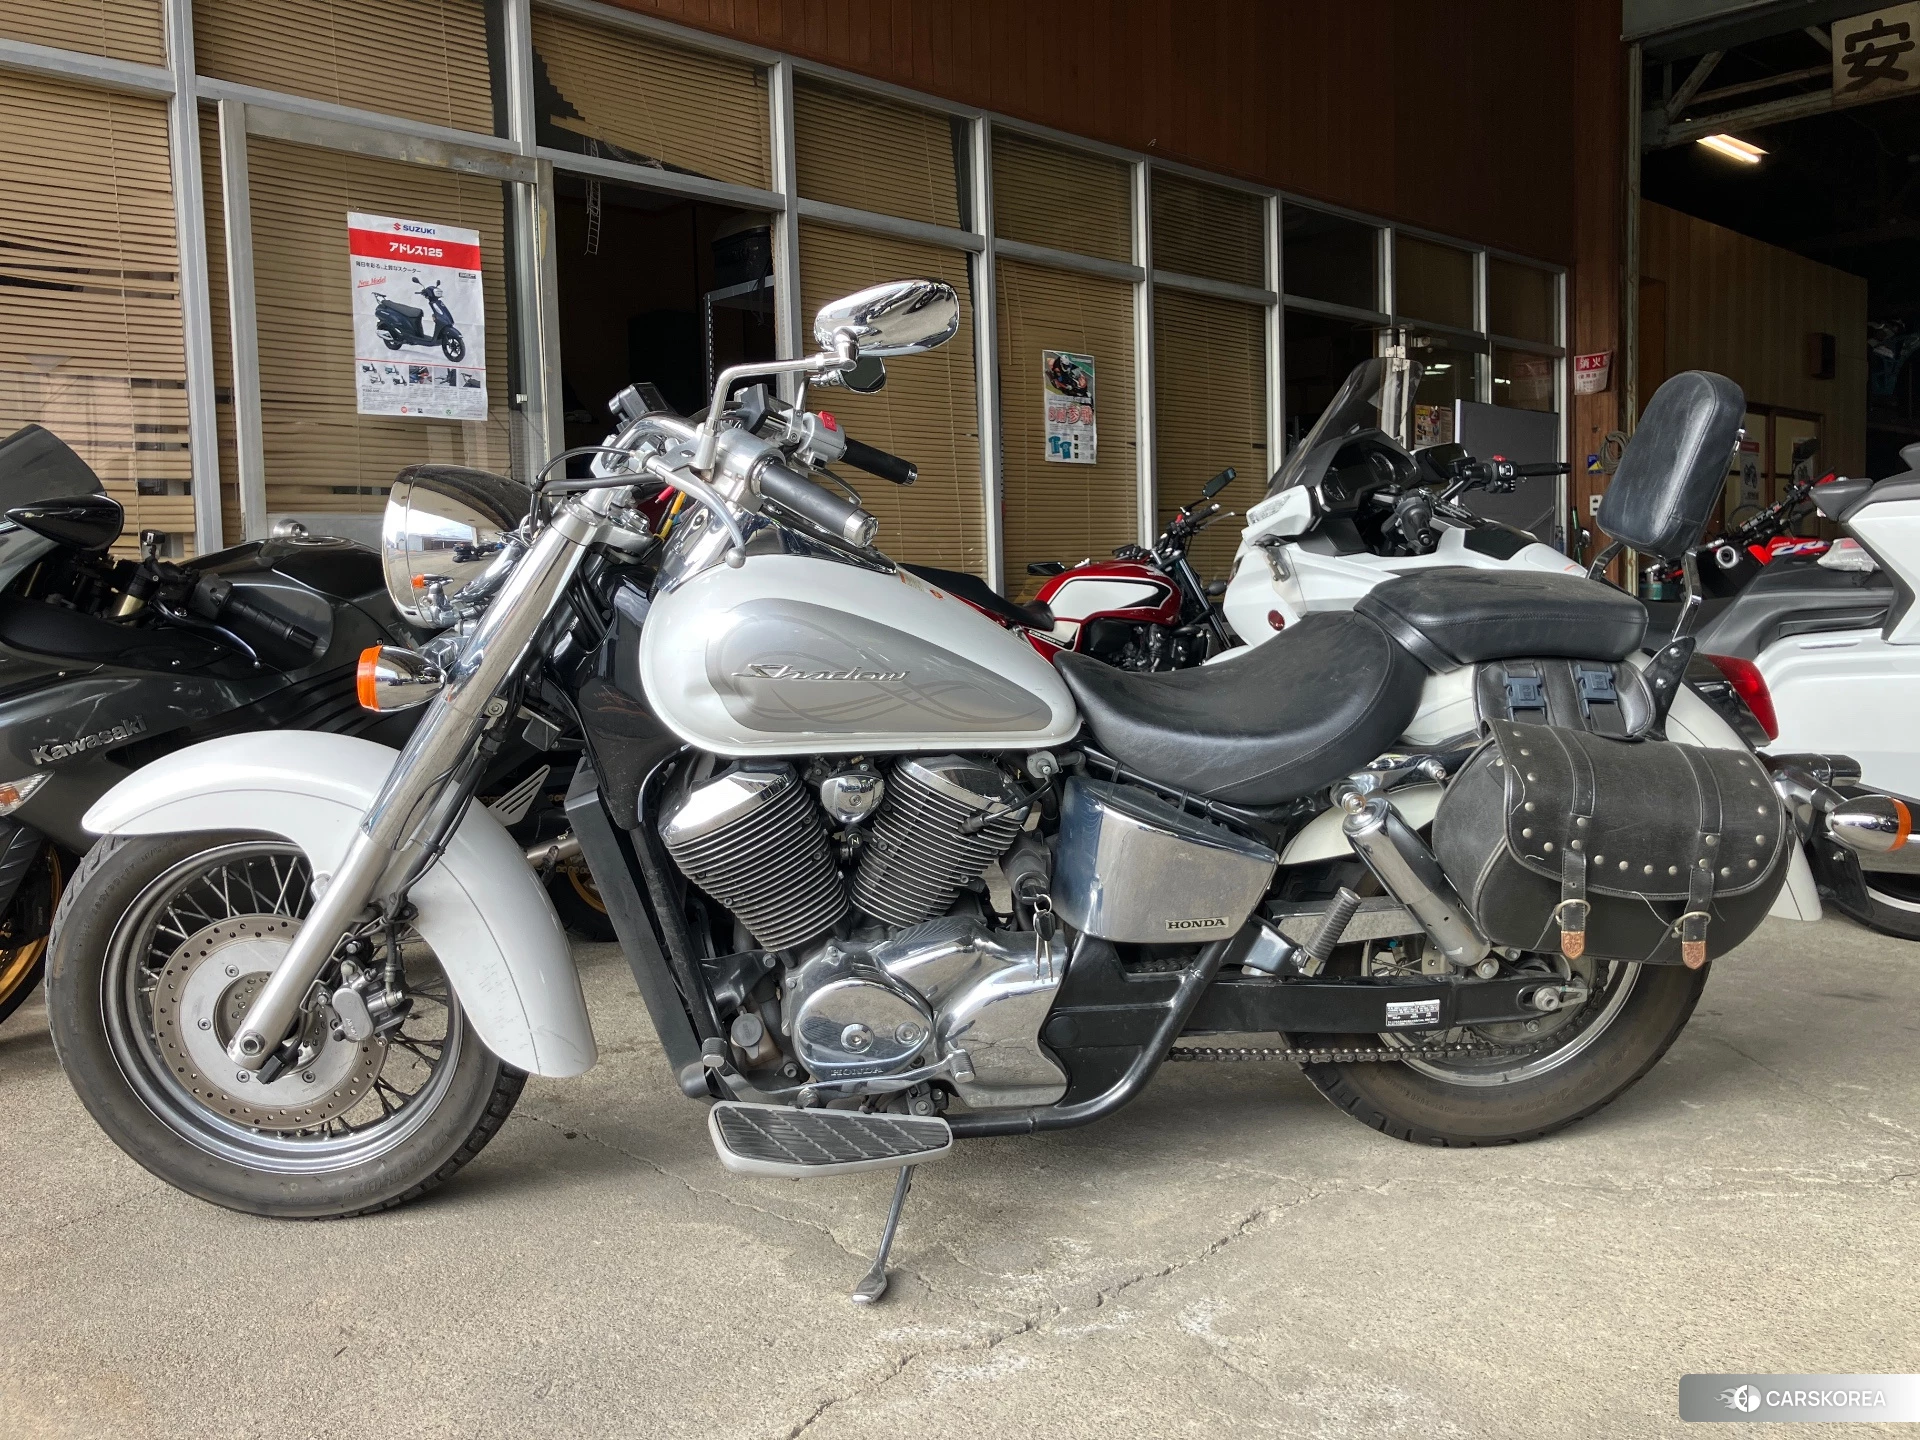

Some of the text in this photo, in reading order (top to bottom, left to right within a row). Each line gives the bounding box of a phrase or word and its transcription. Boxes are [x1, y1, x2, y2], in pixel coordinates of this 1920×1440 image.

[1841, 18, 1915, 93] 安
[402, 224, 436, 235] SUZUKI
[389, 242, 443, 258] アドレス125
[731, 663, 910, 682] Shadow
[30, 715, 147, 765] Kawasaki
[1168, 918, 1226, 930] HONDA
[830, 1067, 884, 1077] HONDA
